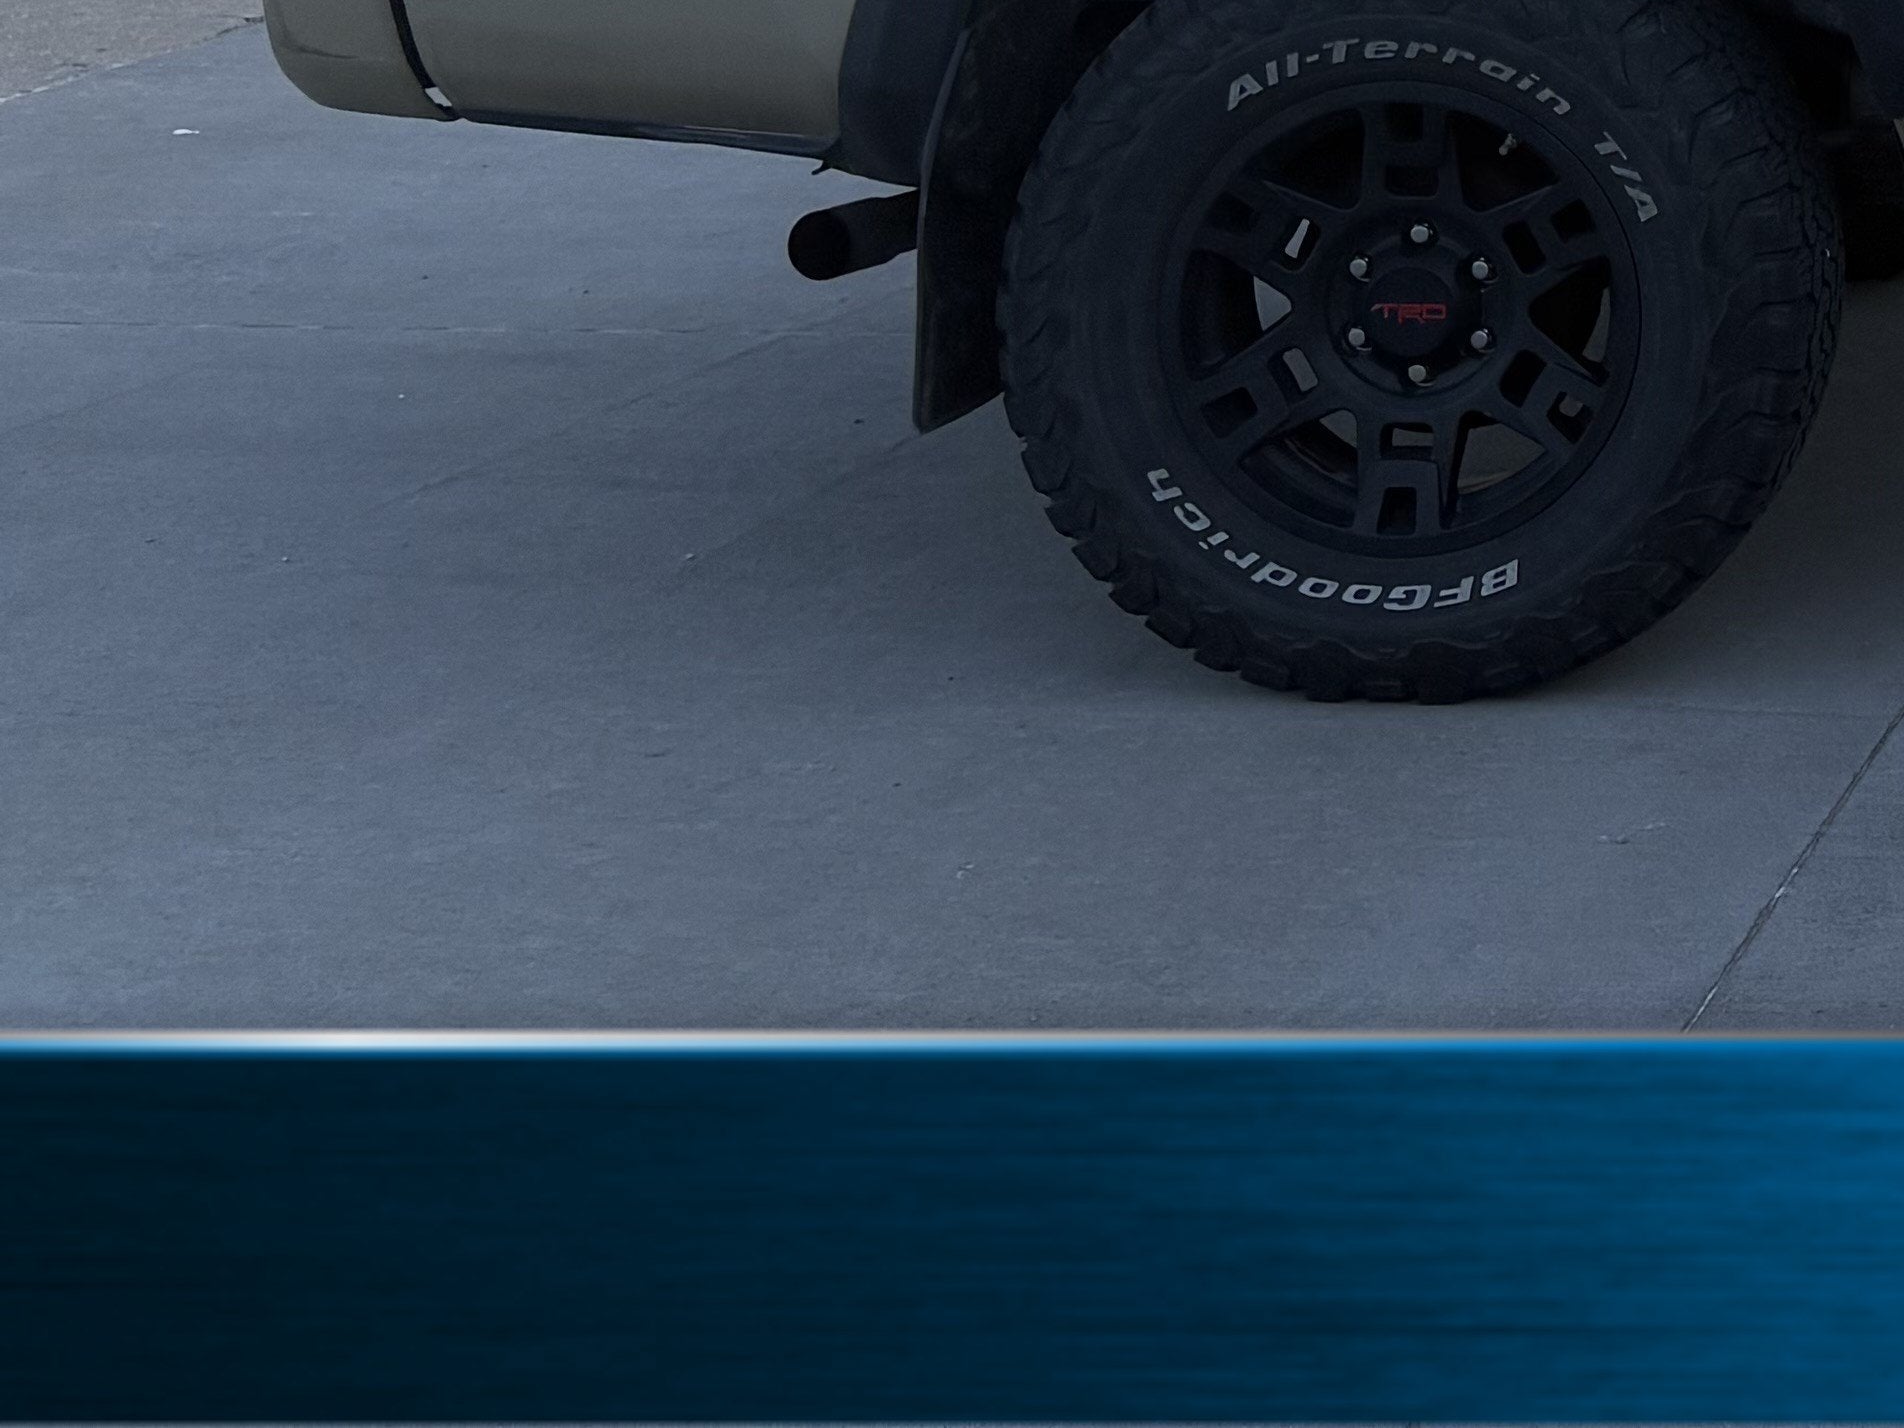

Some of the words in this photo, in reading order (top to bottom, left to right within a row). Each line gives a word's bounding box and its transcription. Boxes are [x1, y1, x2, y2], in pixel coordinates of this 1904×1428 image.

[1225, 37, 1572, 112] All-Terrain
[1593, 131, 1660, 223] T/A
[1370, 302, 1447, 326] TRD
[1146, 467, 1519, 612] BFGoodrich
